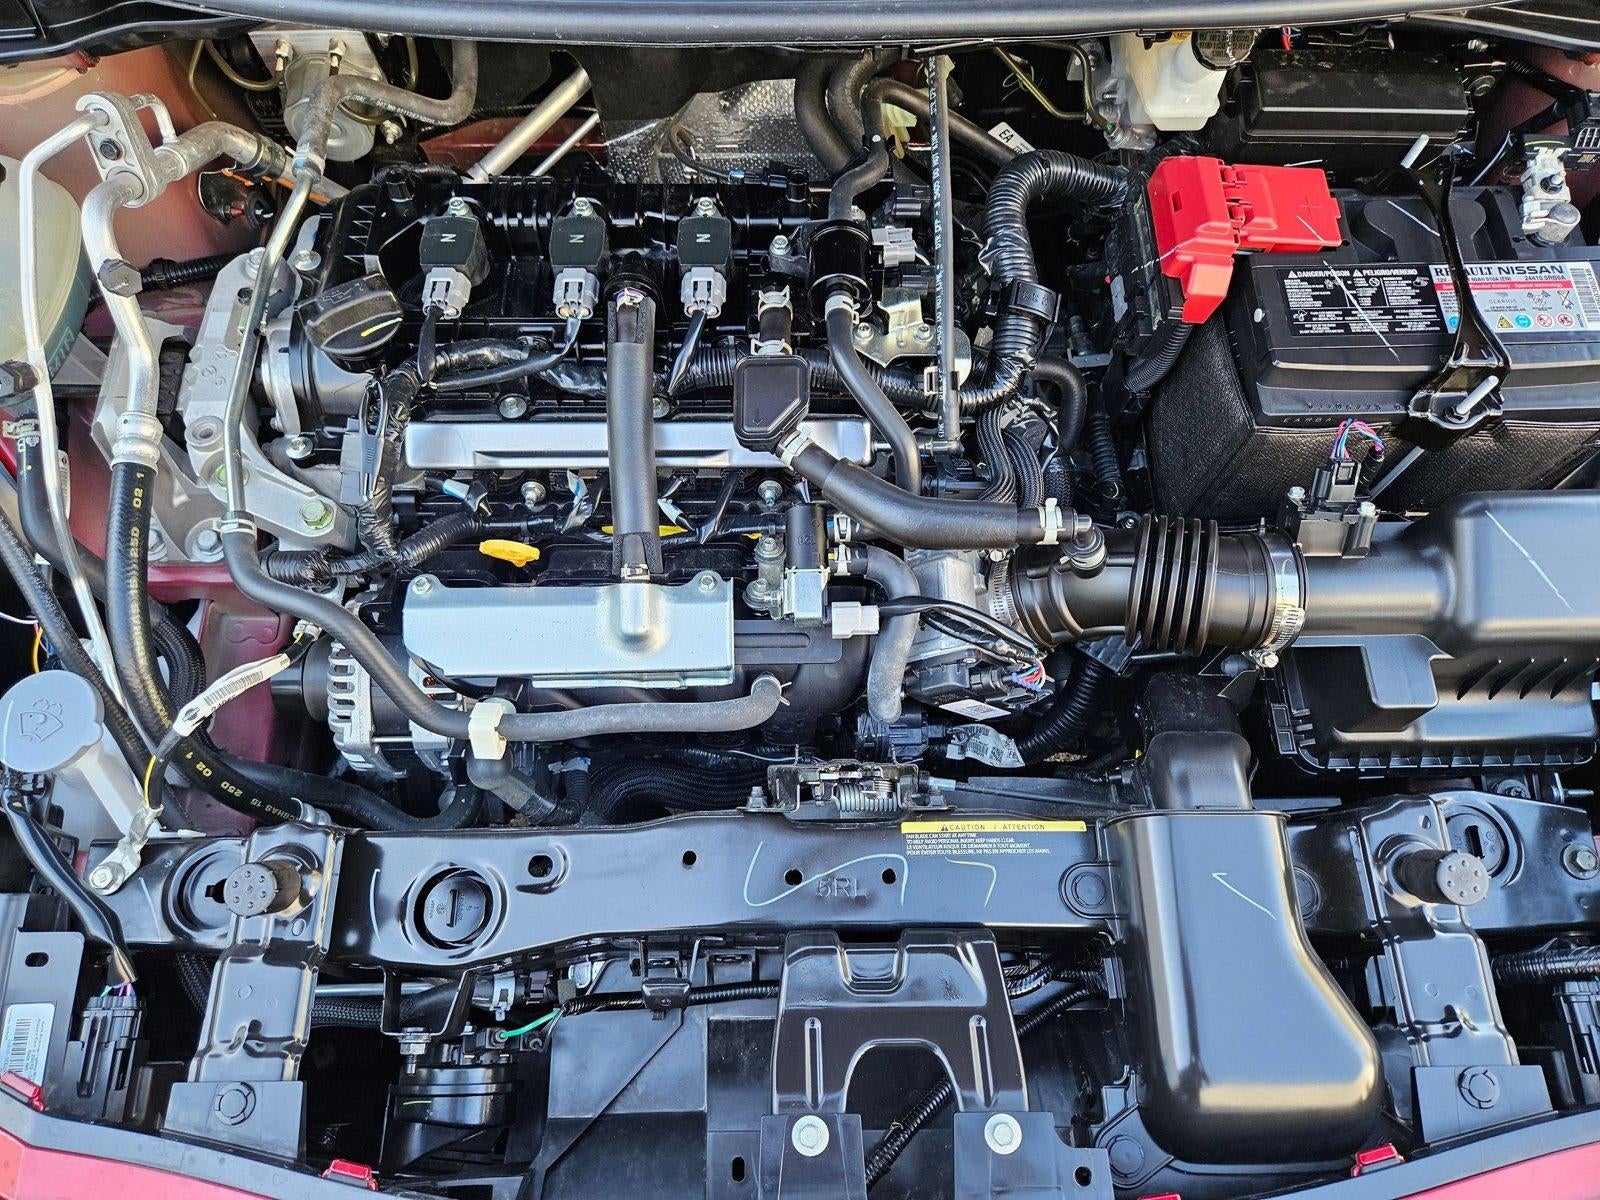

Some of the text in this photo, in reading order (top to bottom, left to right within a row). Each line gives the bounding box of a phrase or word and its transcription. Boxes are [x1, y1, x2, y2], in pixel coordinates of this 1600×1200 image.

[998, 129, 1014, 143] EA
[1498, 265, 1564, 275] NISSAN
[195, 762, 213, 777] 02
[220, 781, 243, 796] 25D
[250, 798, 262, 807] 15
